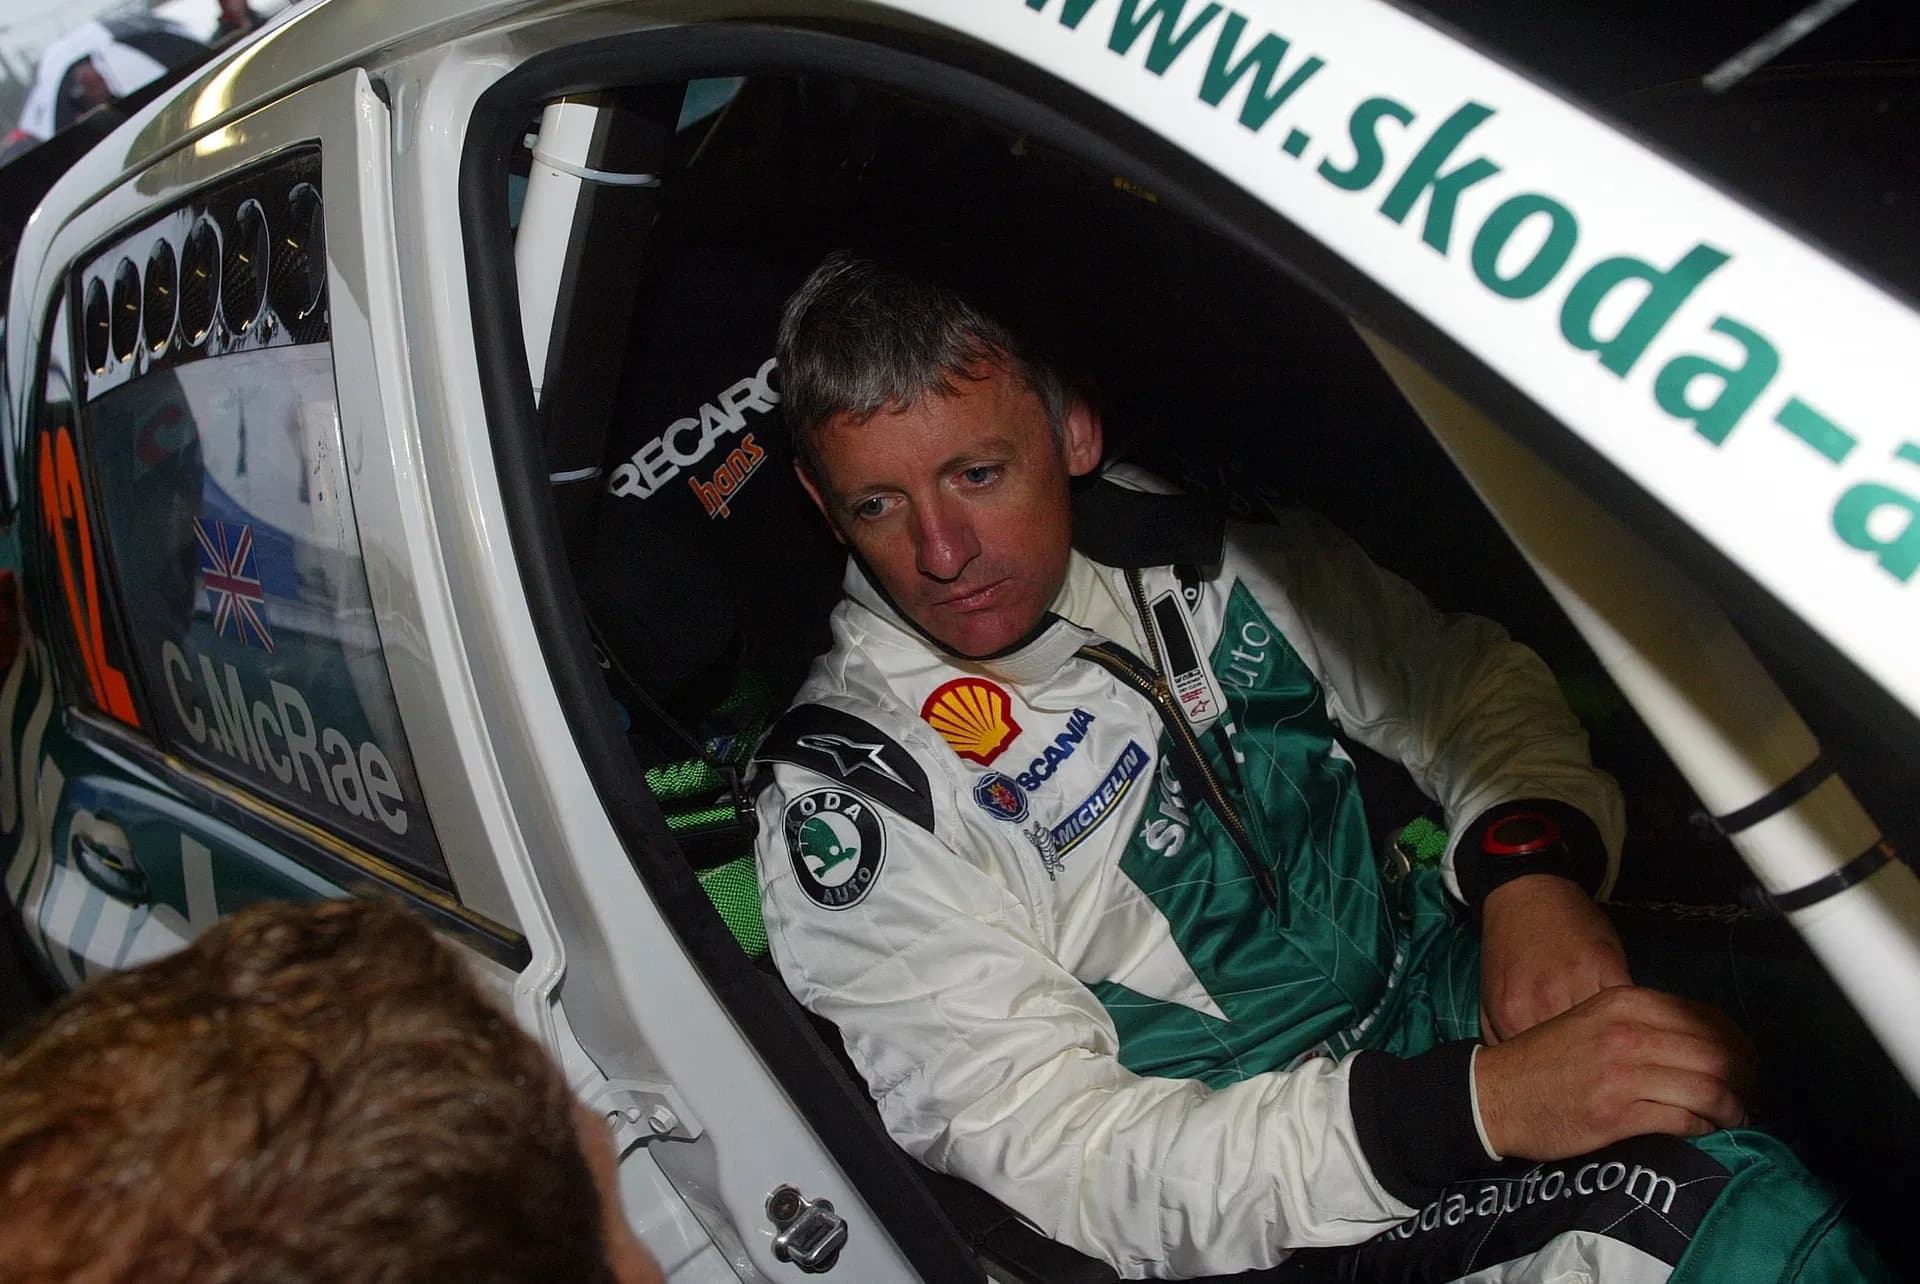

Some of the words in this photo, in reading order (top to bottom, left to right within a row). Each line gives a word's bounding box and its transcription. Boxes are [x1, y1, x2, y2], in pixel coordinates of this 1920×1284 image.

[688, 433, 766, 520] hans
[38, 426, 140, 729] 12
[1225, 621, 1270, 689] uto
[162, 639, 408, 836] C.McRae
[1015, 707, 1096, 792] SCANIA
[1057, 749, 1139, 847] MICHELIN
[1377, 1161, 1677, 1241] oda-auto.com
